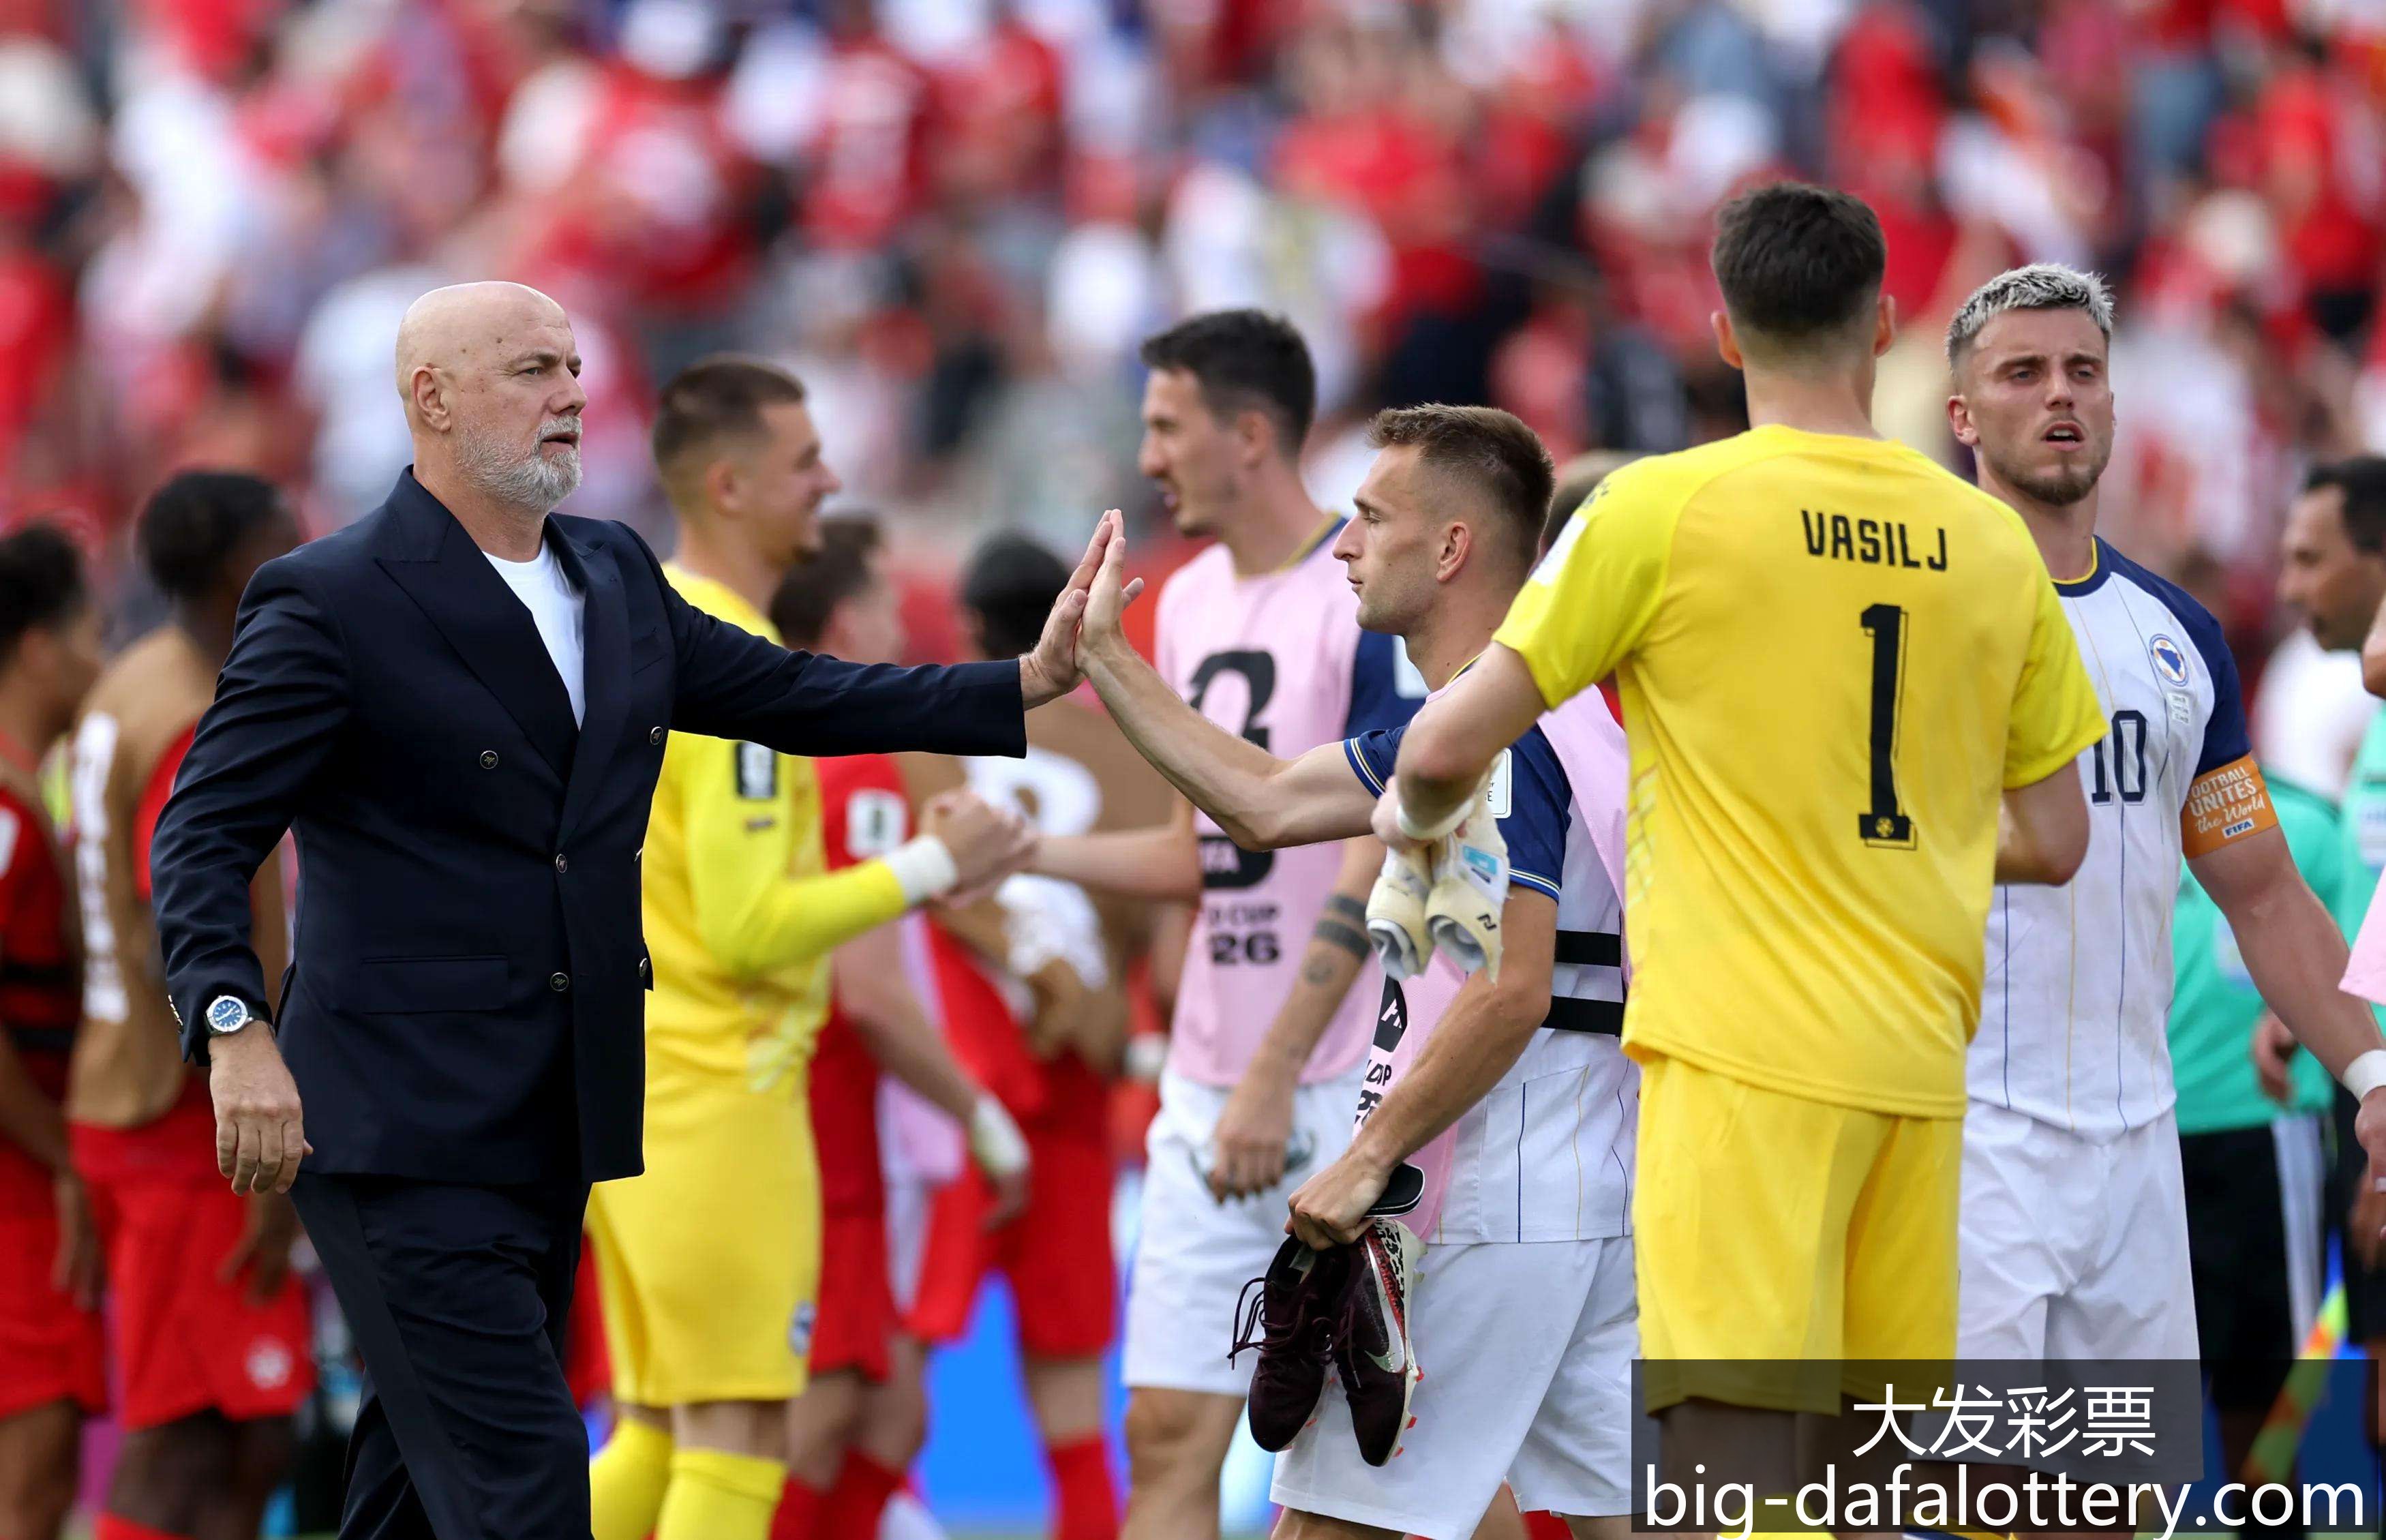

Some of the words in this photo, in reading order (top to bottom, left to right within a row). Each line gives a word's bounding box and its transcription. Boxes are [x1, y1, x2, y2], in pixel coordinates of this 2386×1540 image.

[1801, 509, 1947, 573] VASILJ
[1859, 603, 1917, 850] 1
[2091, 710, 2149, 806] 10
[2187, 766, 2250, 801] OOTBALL
[2190, 777, 2256, 817] UNITES
[2195, 816, 2222, 834] the
[2223, 793, 2266, 823] World
[2224, 820, 2252, 836] FIFA
[1209, 932, 1280, 965] 26
